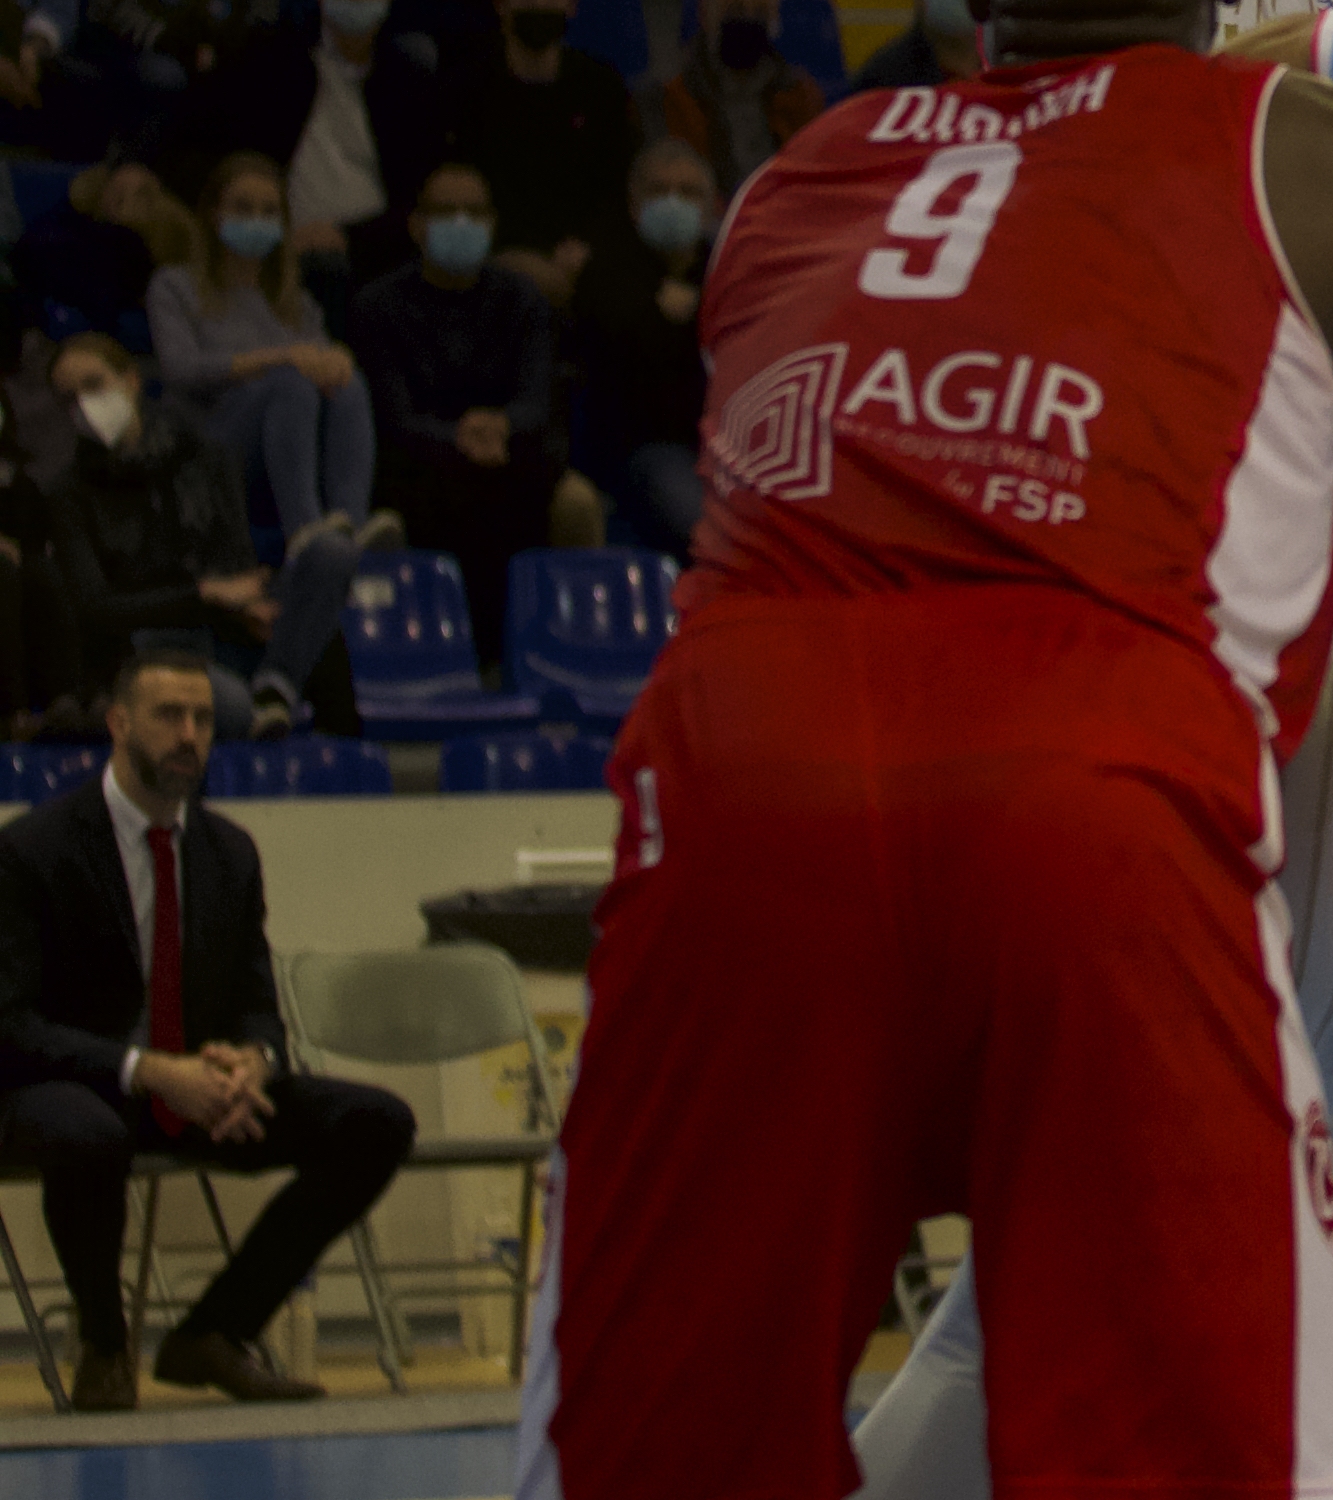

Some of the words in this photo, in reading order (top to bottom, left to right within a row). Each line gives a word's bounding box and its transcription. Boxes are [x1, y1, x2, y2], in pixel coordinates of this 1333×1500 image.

[858, 139, 1024, 300] 9
[840, 346, 1105, 460] AGIR
[979, 472, 1088, 526] FSP
